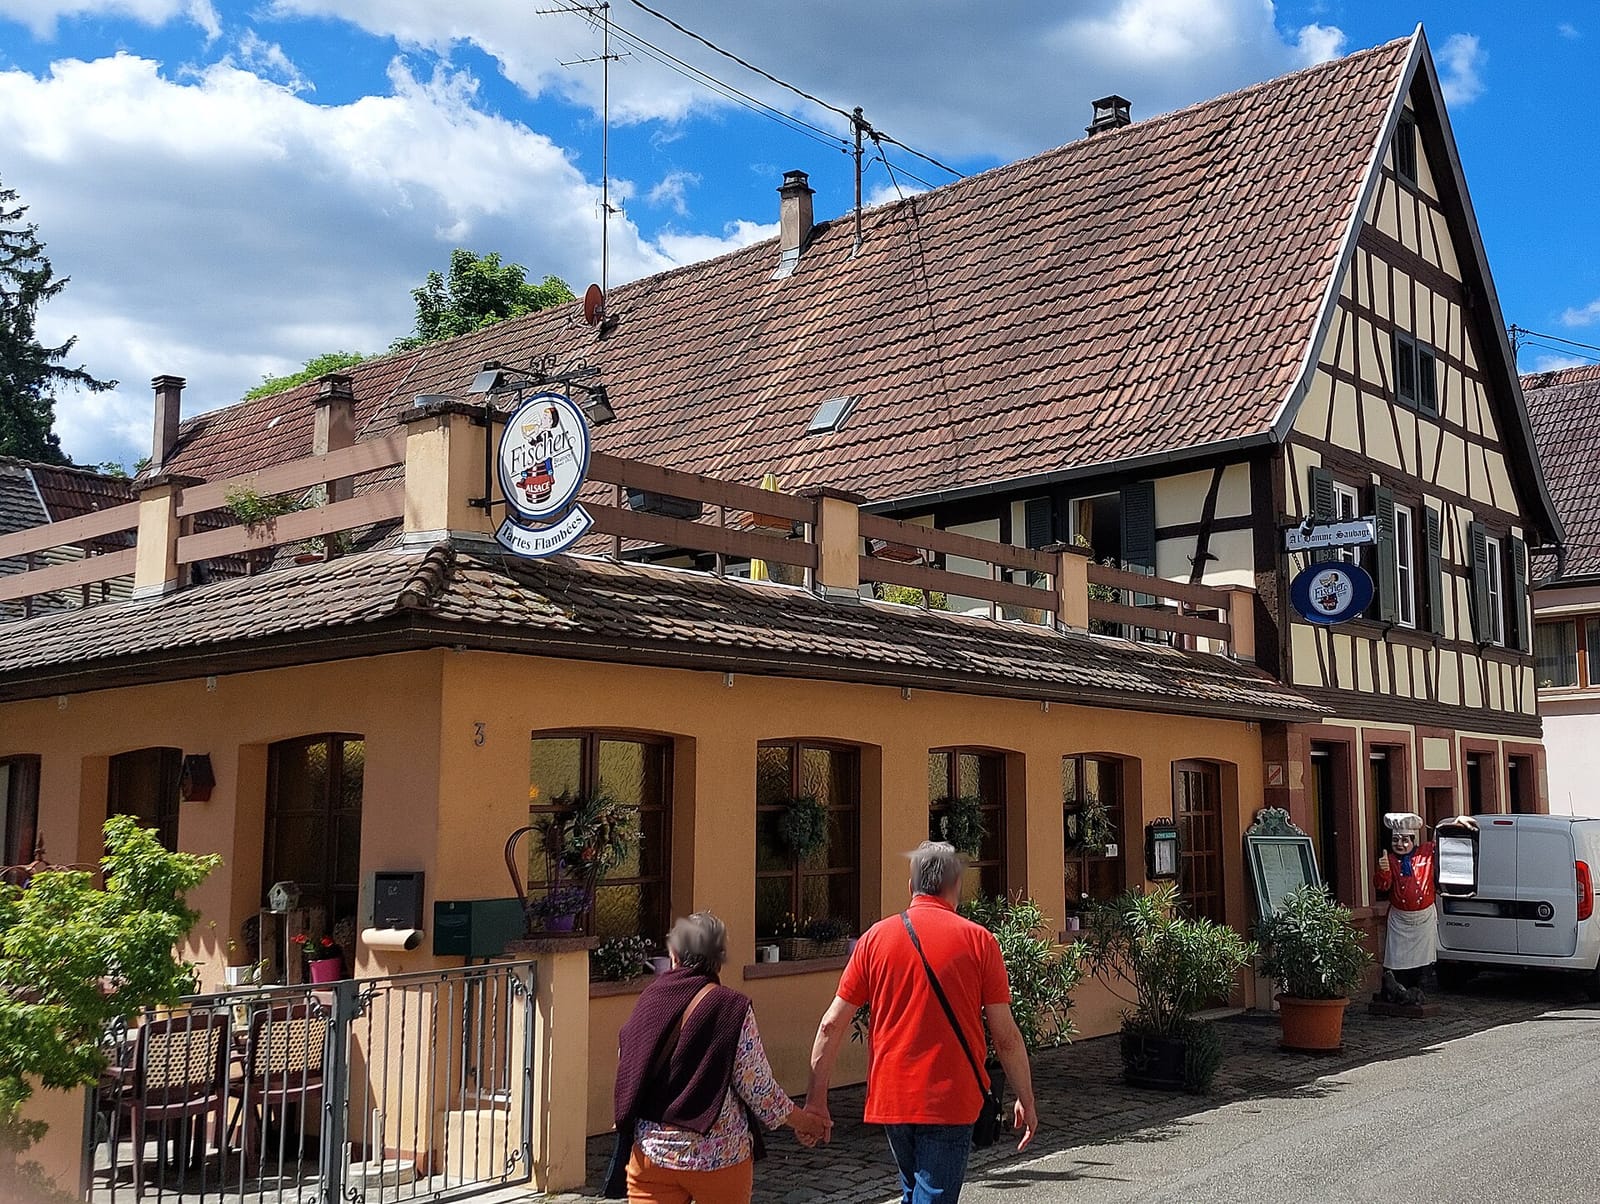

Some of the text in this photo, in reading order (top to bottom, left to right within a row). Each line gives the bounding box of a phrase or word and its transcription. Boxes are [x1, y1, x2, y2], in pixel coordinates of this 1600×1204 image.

[510, 429, 575, 475] Fischer
[525, 481, 551, 492] ALSACE
[502, 515, 583, 551] Tartes Flambées
[474, 722, 486, 747] 3
